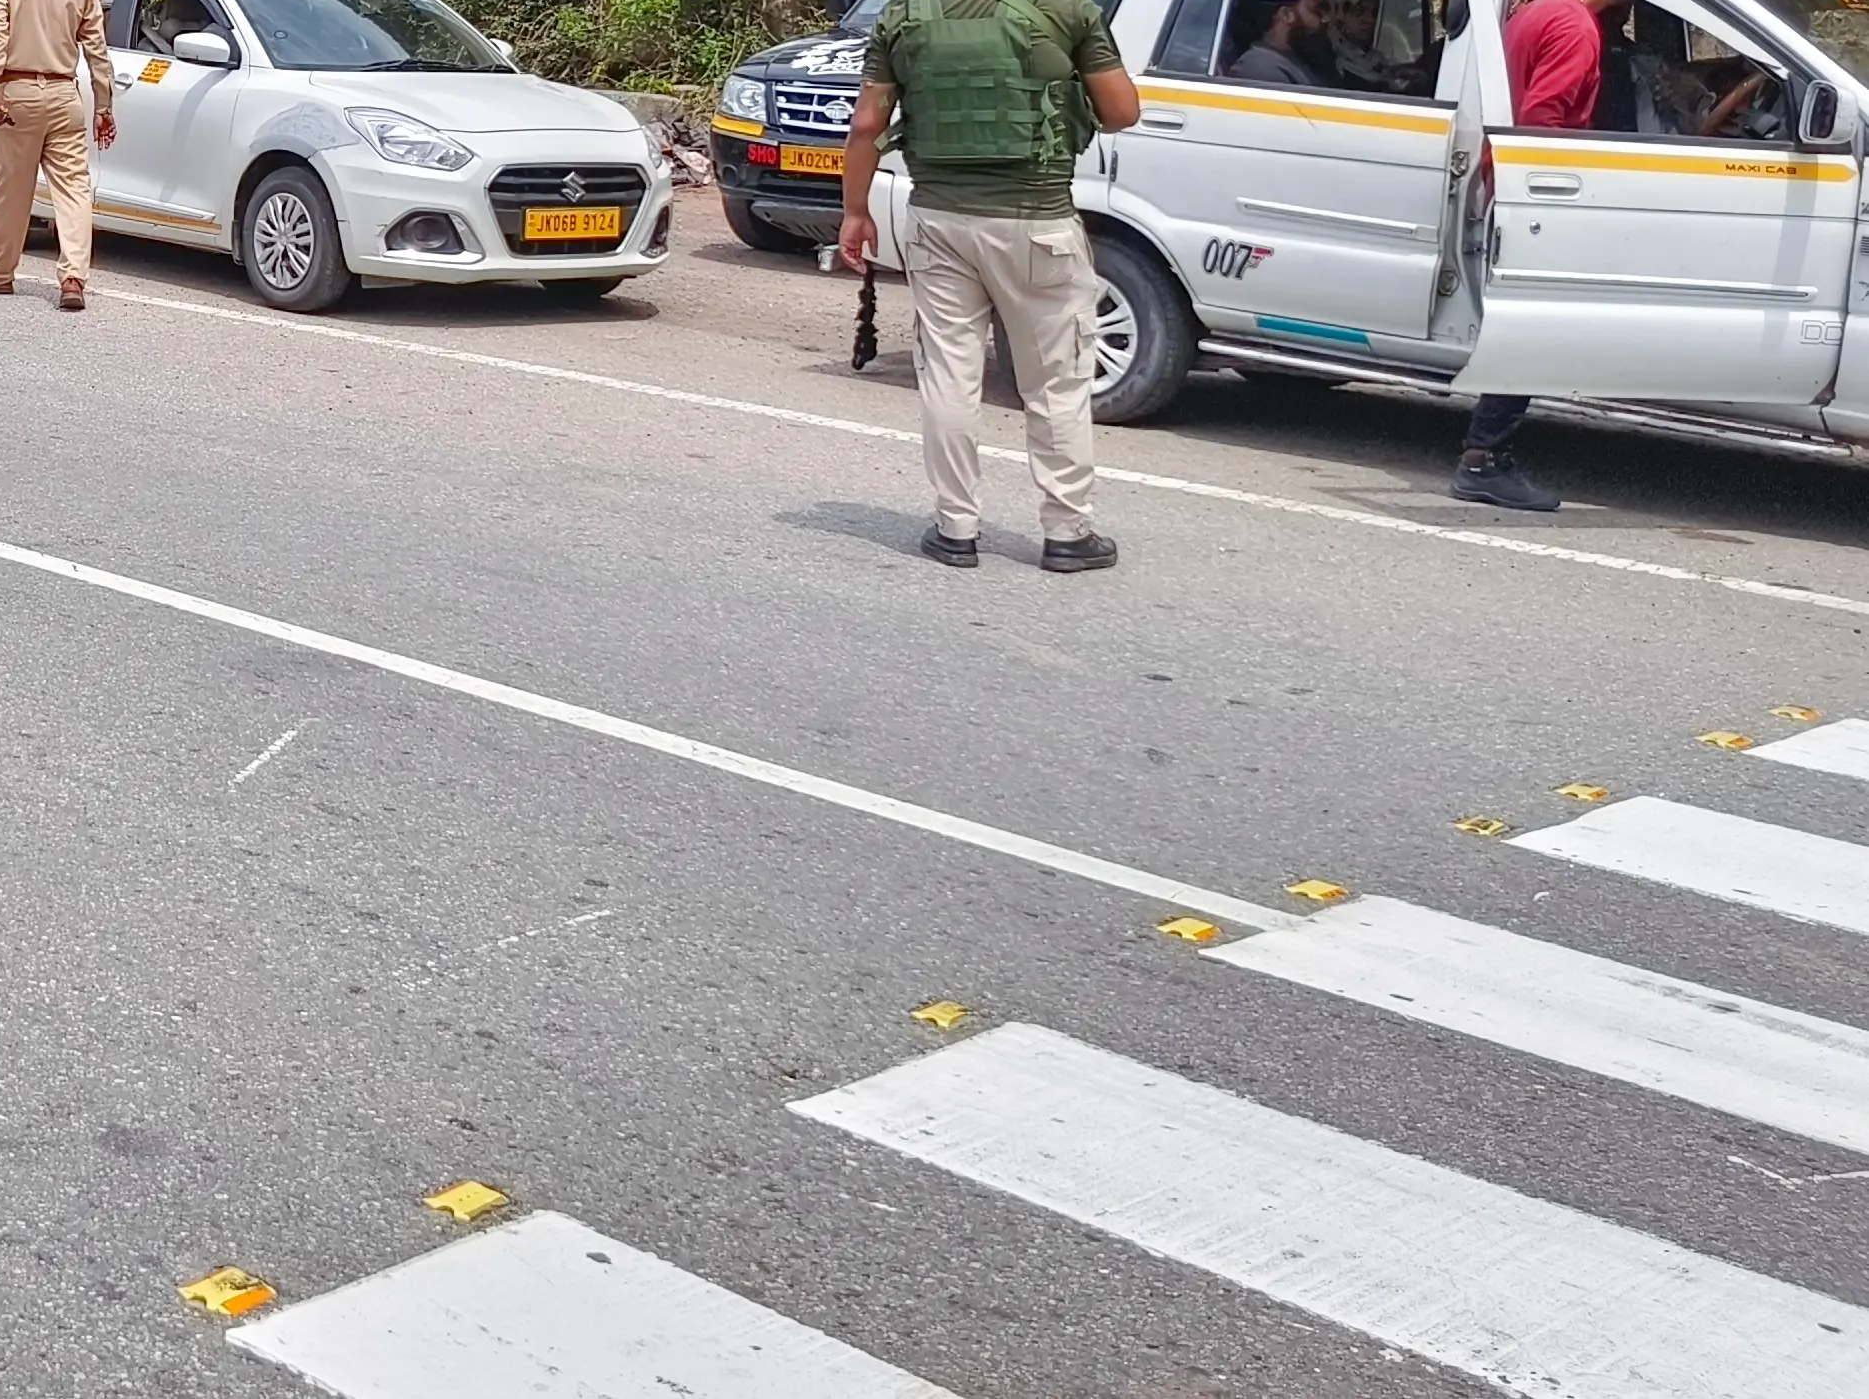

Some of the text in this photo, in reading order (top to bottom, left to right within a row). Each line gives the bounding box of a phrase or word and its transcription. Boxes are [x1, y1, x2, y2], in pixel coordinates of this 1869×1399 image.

[1725, 163, 1797, 175] MAXI CAB
[583, 213, 615, 231] 9124
[1202, 236, 1253, 280] 007
